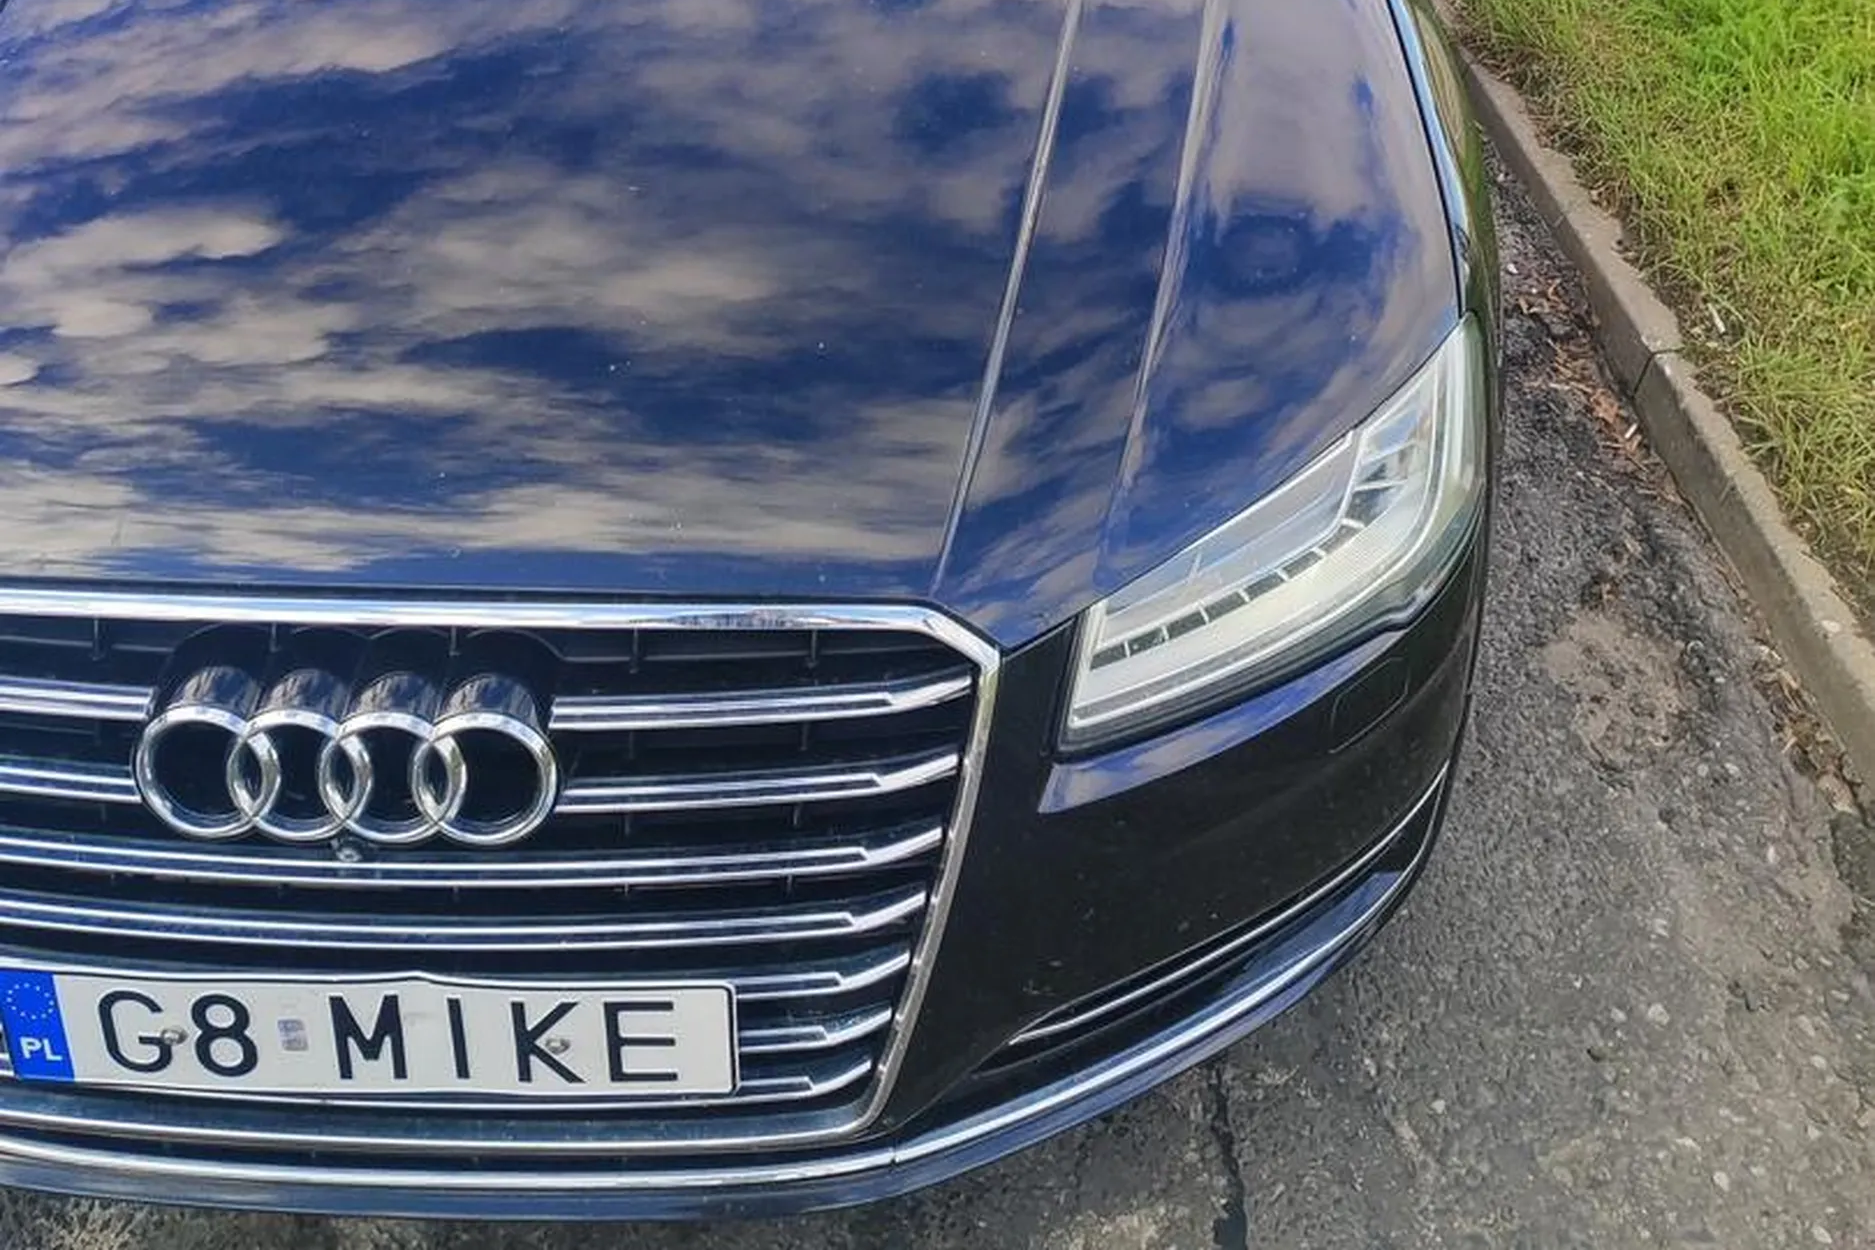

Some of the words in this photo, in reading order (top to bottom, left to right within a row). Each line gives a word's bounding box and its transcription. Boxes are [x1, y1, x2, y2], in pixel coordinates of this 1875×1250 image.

[20, 1036, 63, 1062] PL
[99, 990, 259, 1078] G8
[328, 994, 680, 1083] MIKE
